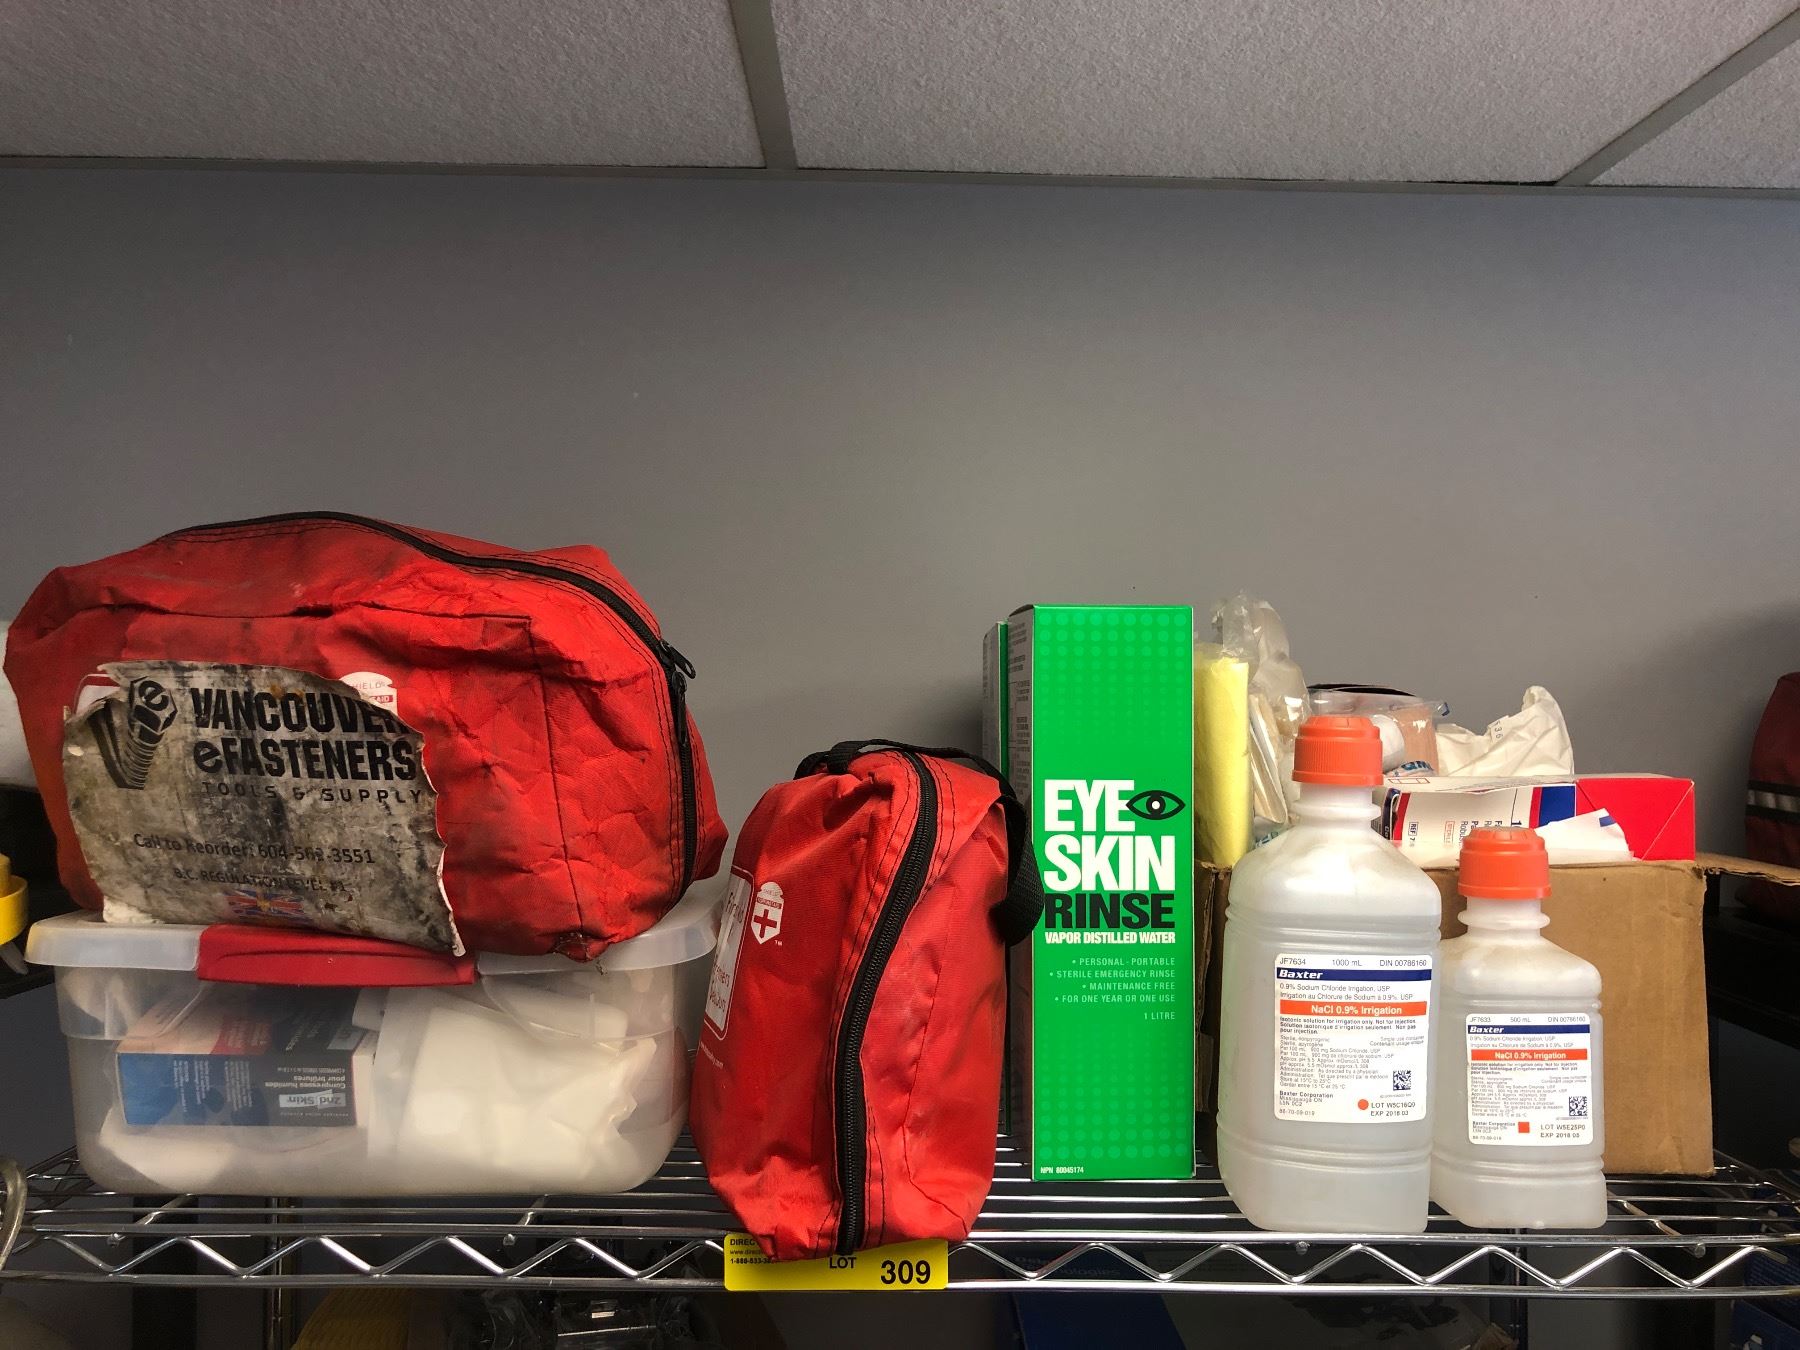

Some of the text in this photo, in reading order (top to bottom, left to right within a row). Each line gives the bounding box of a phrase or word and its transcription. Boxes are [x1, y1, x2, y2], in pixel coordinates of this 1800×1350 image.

[202, 782, 277, 799] TOOLS
[321, 788, 421, 804] SUPPLY
[1044, 779, 1136, 832] EYE
[133, 833, 160, 849] Call
[166, 839, 182, 850] to
[1043, 833, 1176, 892] SKIN
[1044, 892, 1176, 930] RINSE
[1045, 931, 1176, 944] VAPOR DISTILLED WATER
[1079, 958, 1176, 966] PERSONAL PORTABLE
[1056, 970, 1176, 978] STERILE EMERGENCY RINSE
[1278, 969, 1324, 979] Baxter
[1089, 982, 1176, 990] MAINTENANCE FREE
[1062, 994, 1176, 1002] FOR ONE YEAR OR ONE USE
[1151, 1012, 1176, 1020] LITRE
[1311, 1004, 1402, 1016] NaCl 0.9% Irrigation
[1534, 1052, 1567, 1060] Irrigation
[288, 1096, 315, 1105] Skin
[829, 1257, 857, 1269] LOT
[880, 1260, 931, 1285] 309
